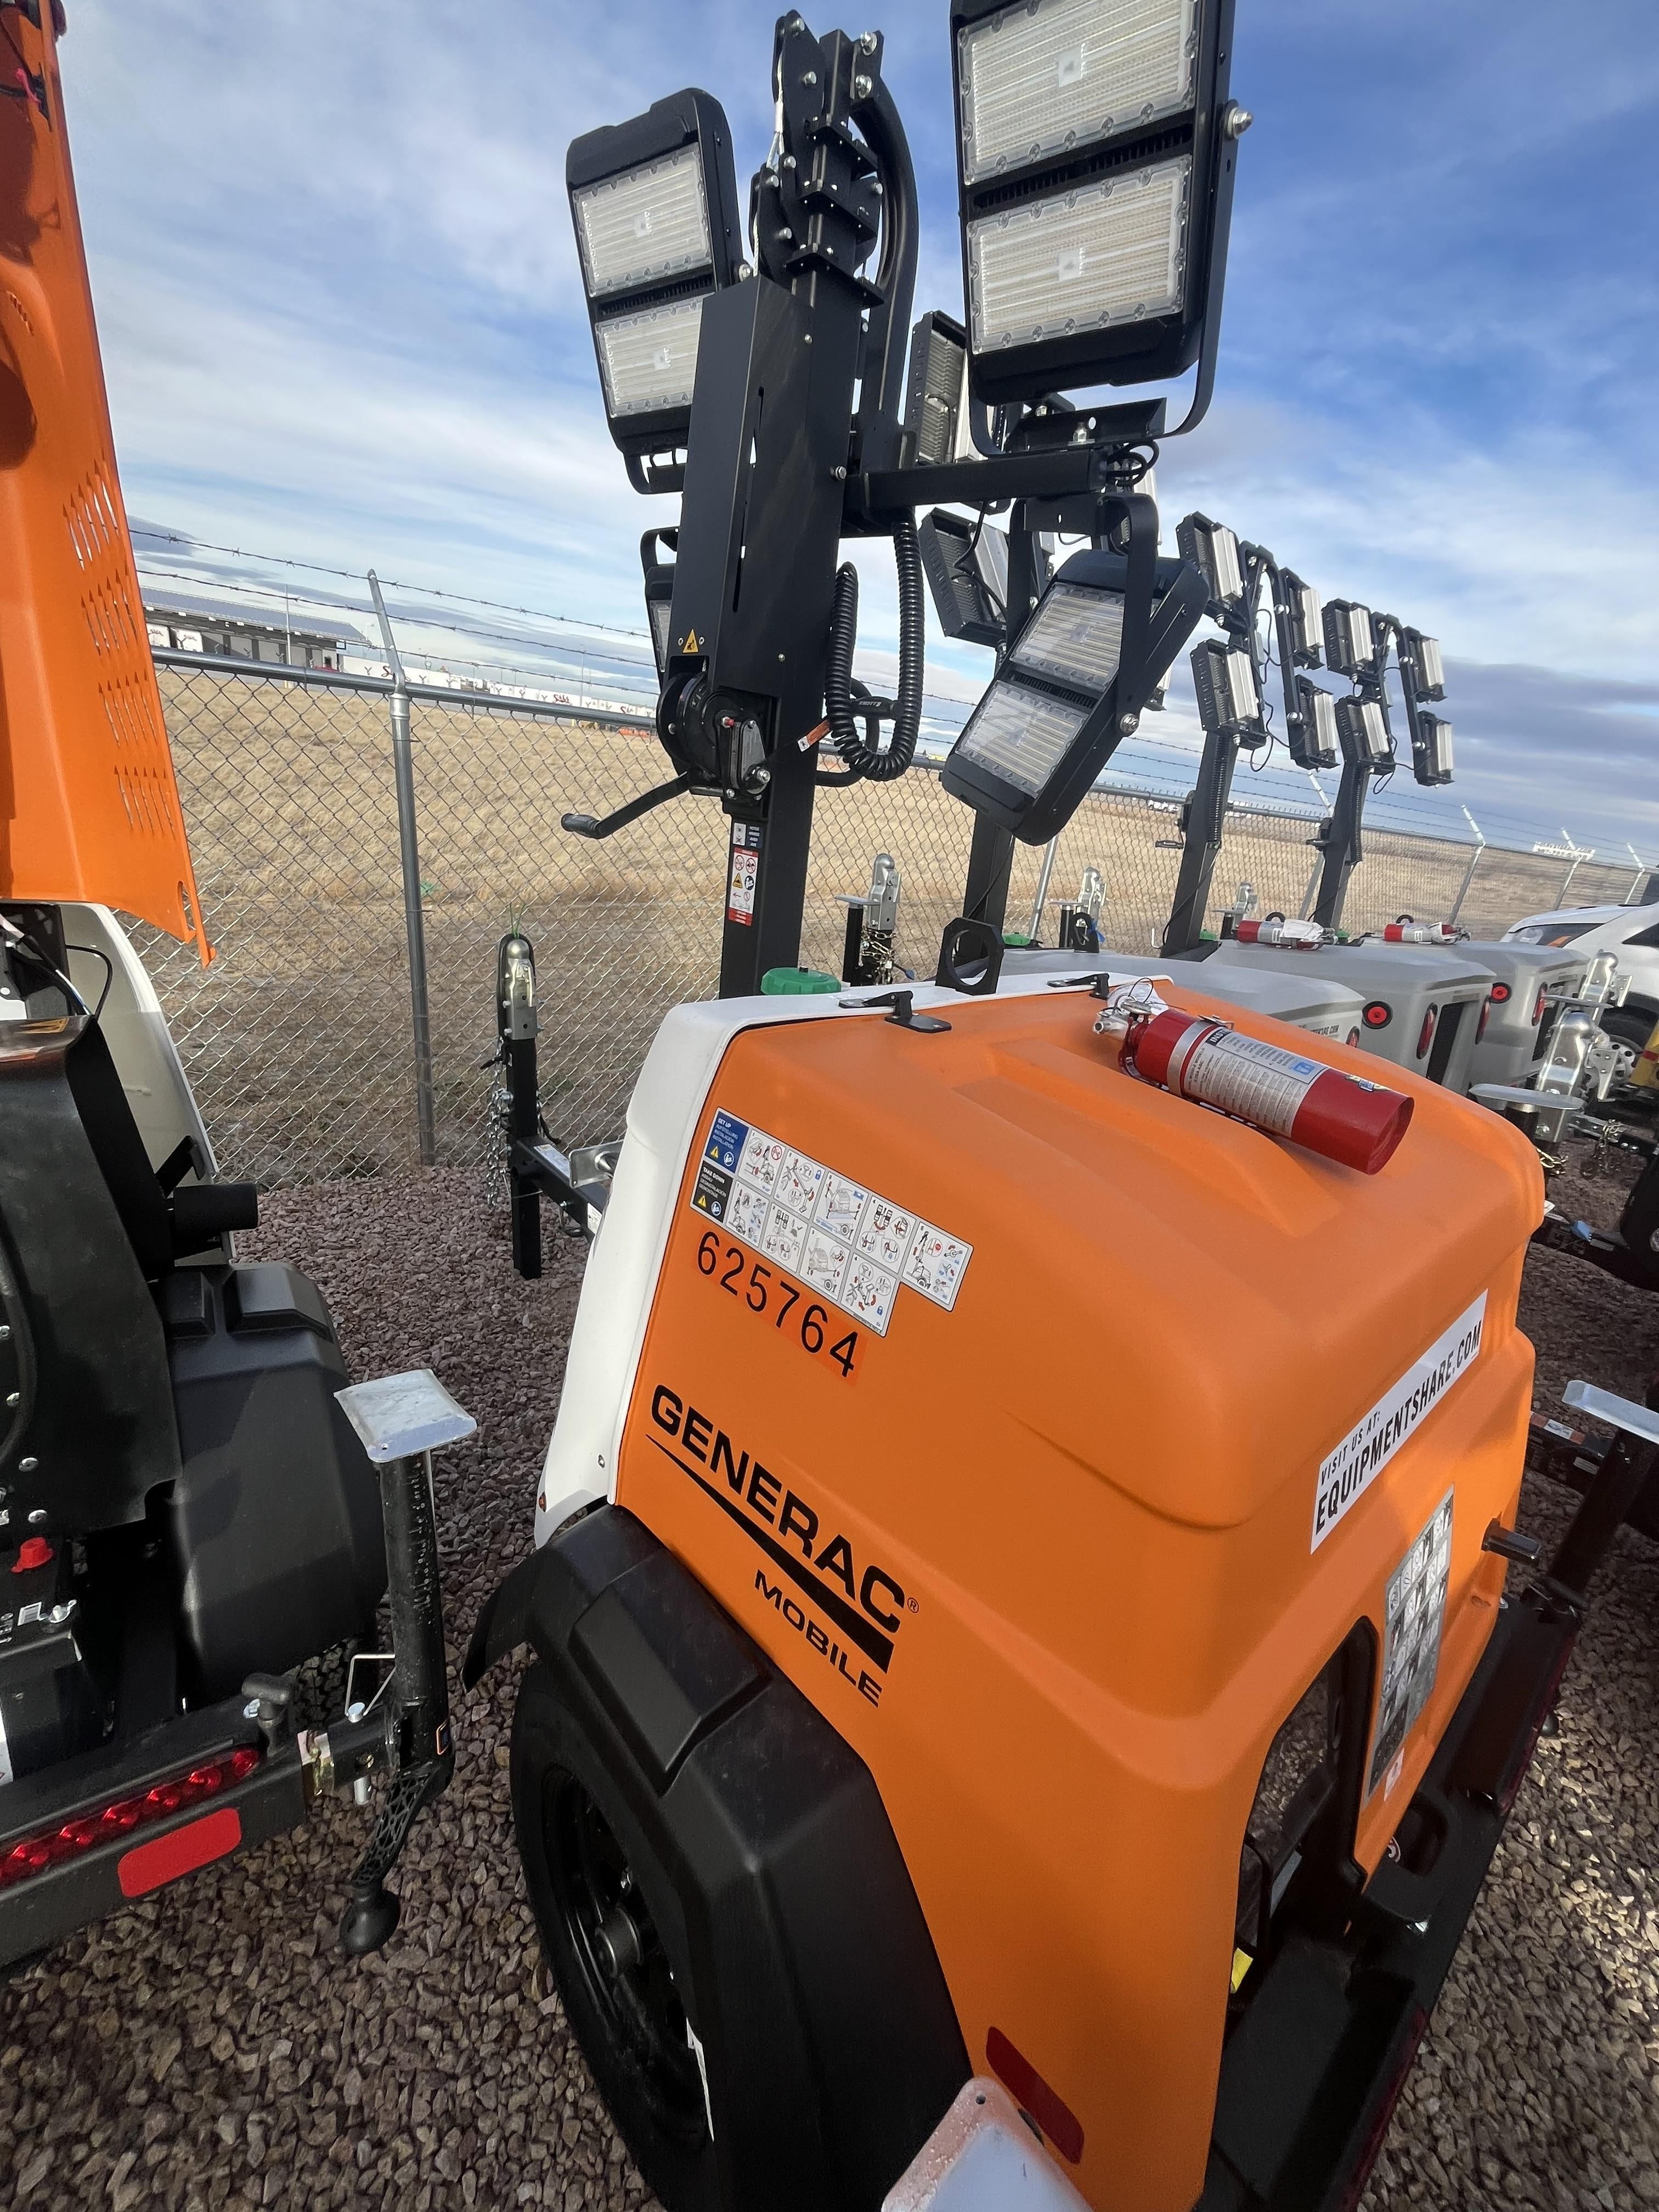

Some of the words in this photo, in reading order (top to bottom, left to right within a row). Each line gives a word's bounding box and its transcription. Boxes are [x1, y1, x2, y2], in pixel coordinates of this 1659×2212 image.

[697, 1231, 859, 1378] 625764
[1316, 1320, 1482, 1536] EQUIPMENTSHARE.COM
[1320, 1444, 1348, 1485] VISIT
[1352, 1427, 1364, 1453] US
[1366, 1412, 1381, 1438] AT:
[754, 1568, 883, 1708] MOBILE
